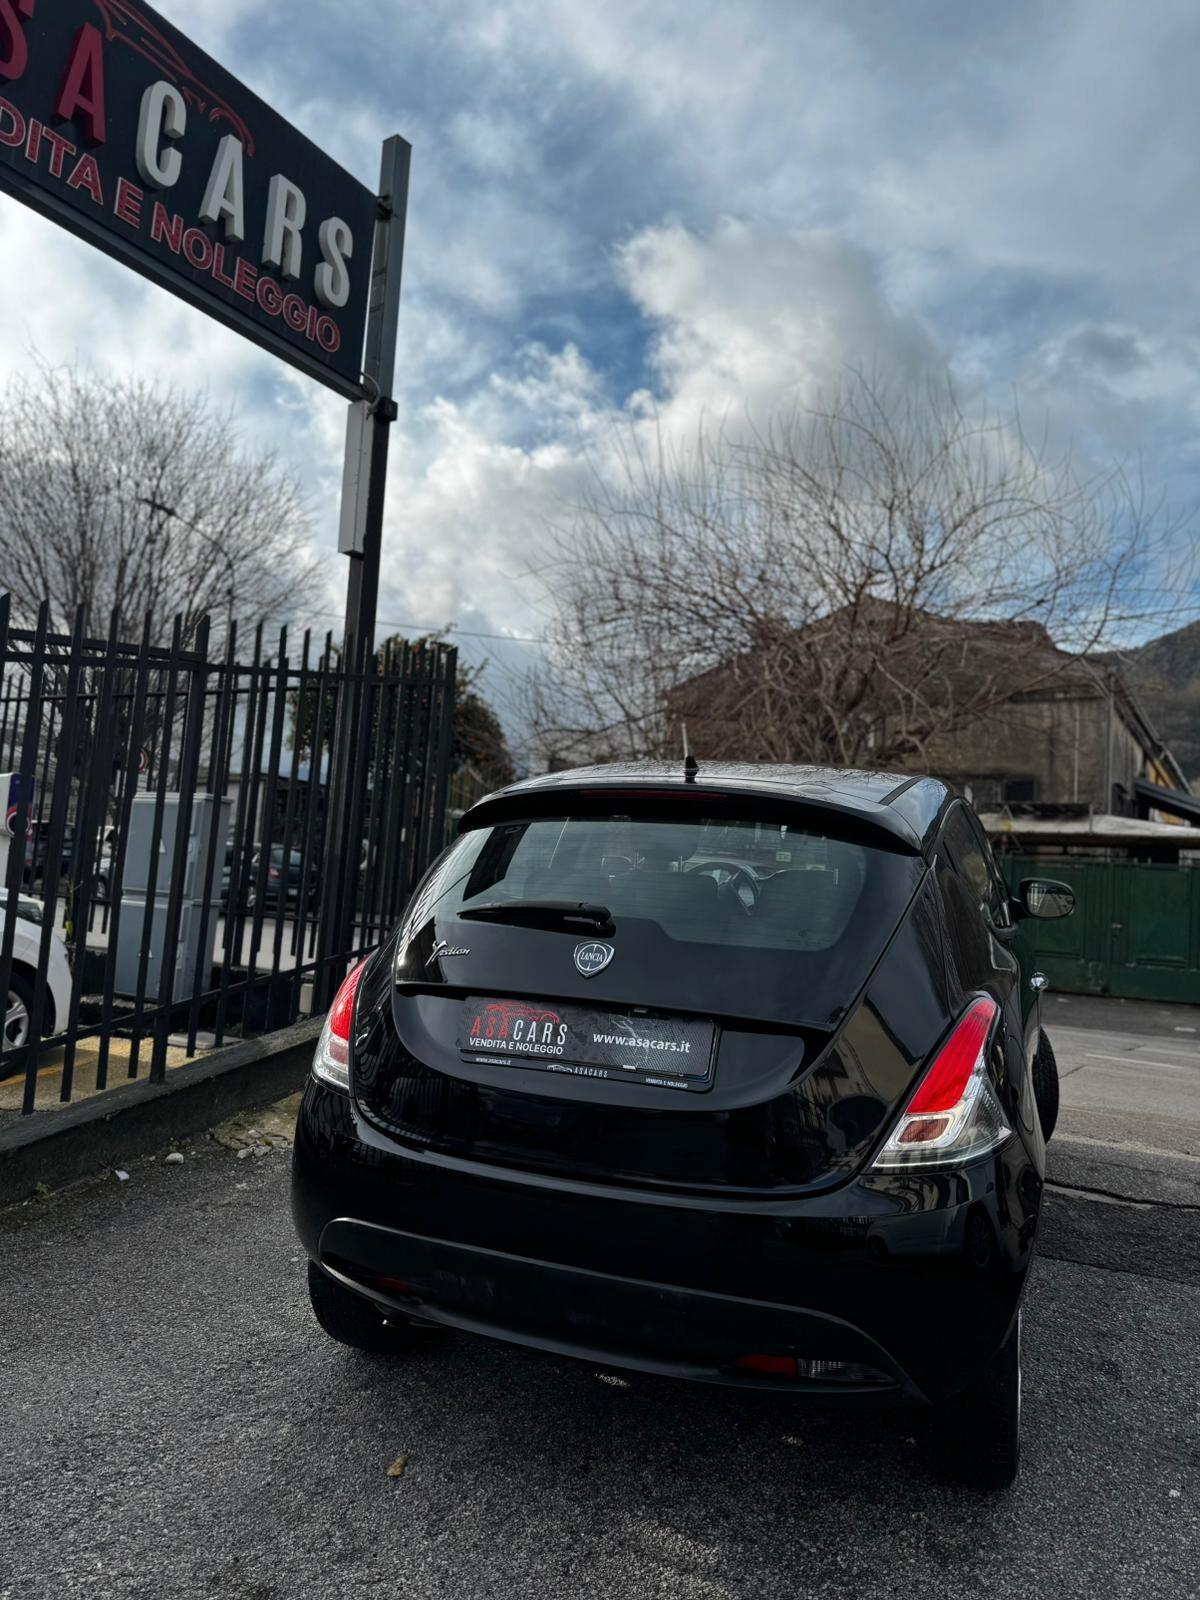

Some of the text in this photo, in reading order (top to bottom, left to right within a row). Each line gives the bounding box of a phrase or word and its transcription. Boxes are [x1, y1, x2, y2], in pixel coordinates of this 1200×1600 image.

[114, 177, 145, 230] E
[150, 202, 341, 353] NOLEGGIO
[580, 951, 603, 962] LANCIA
[469, 1037, 564, 1055] VENDITA E NOLEGGIO
[592, 1033, 691, 1053] www.asacars.it
[573, 1067, 608, 1079] ASACARS
